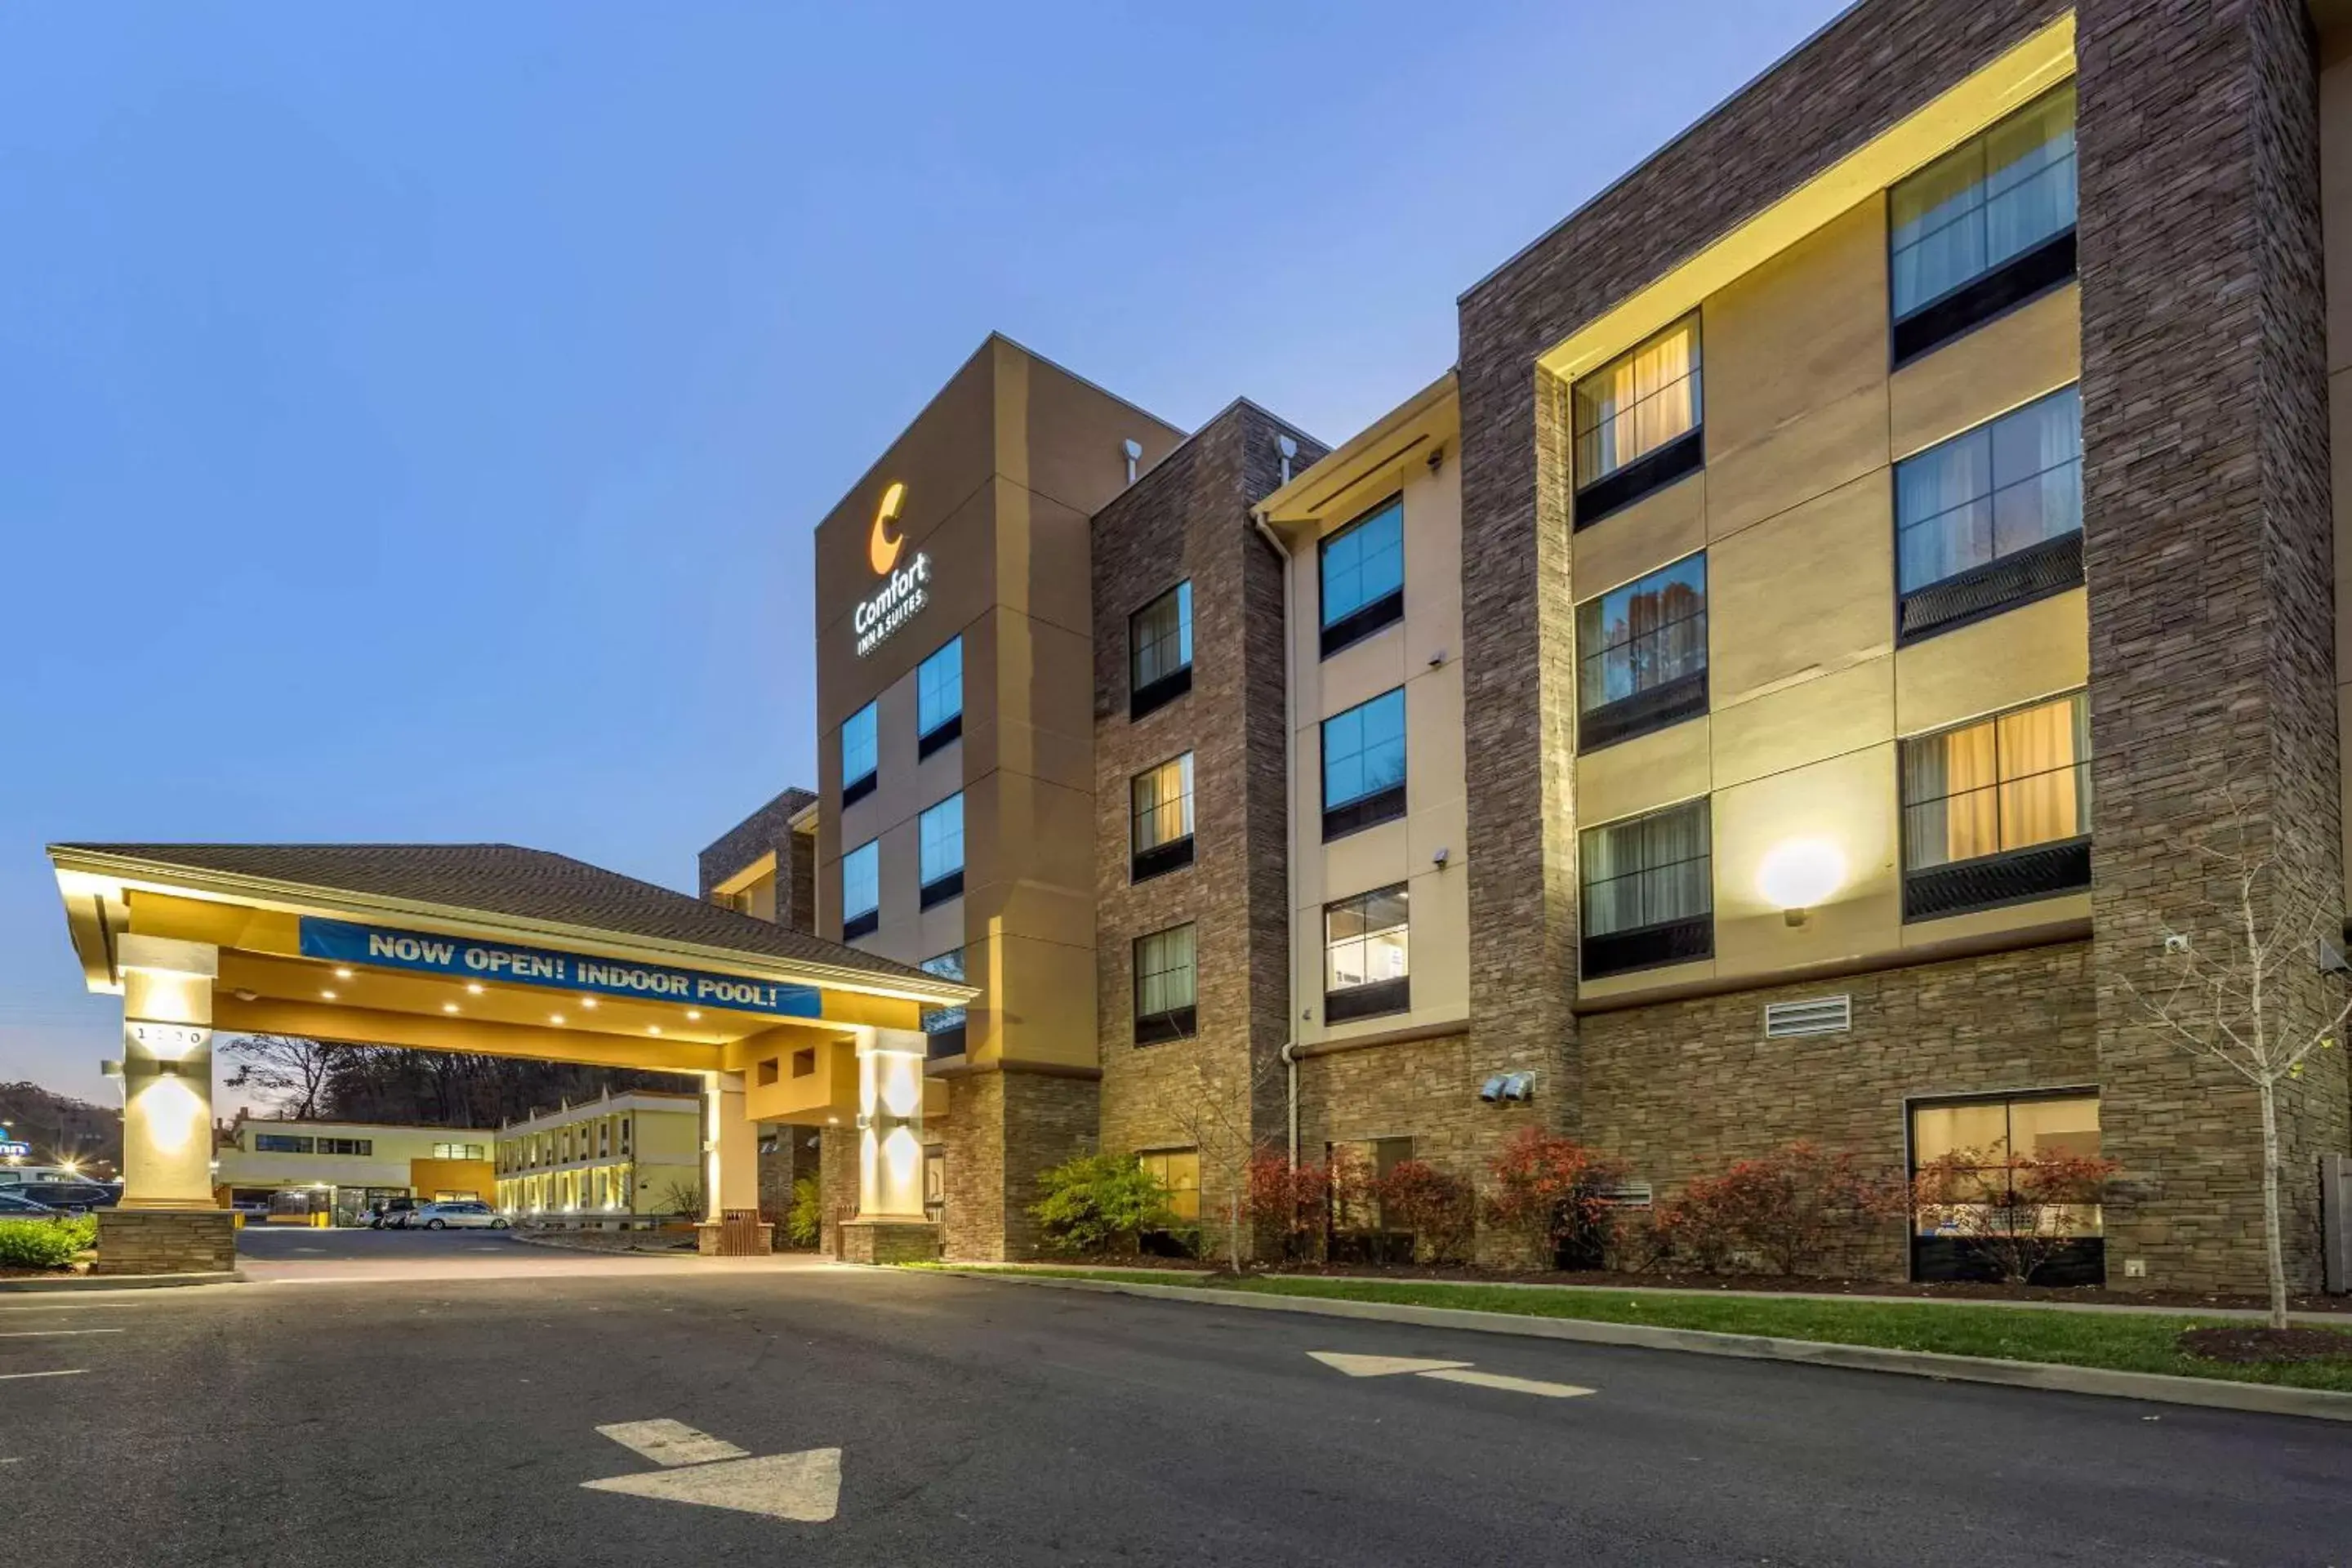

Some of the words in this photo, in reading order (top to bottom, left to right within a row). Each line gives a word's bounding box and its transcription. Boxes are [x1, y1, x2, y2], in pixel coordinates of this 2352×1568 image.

[856, 553, 925, 634] Comfort
[858, 630, 876, 657] INN
[885, 588, 922, 631] SUITES
[369, 933, 454, 964] NOW
[465, 948, 565, 979] OPEN!
[578, 962, 688, 996] INDOOR
[697, 979, 777, 1007] POOL!
[138, 1028, 201, 1044] 10
